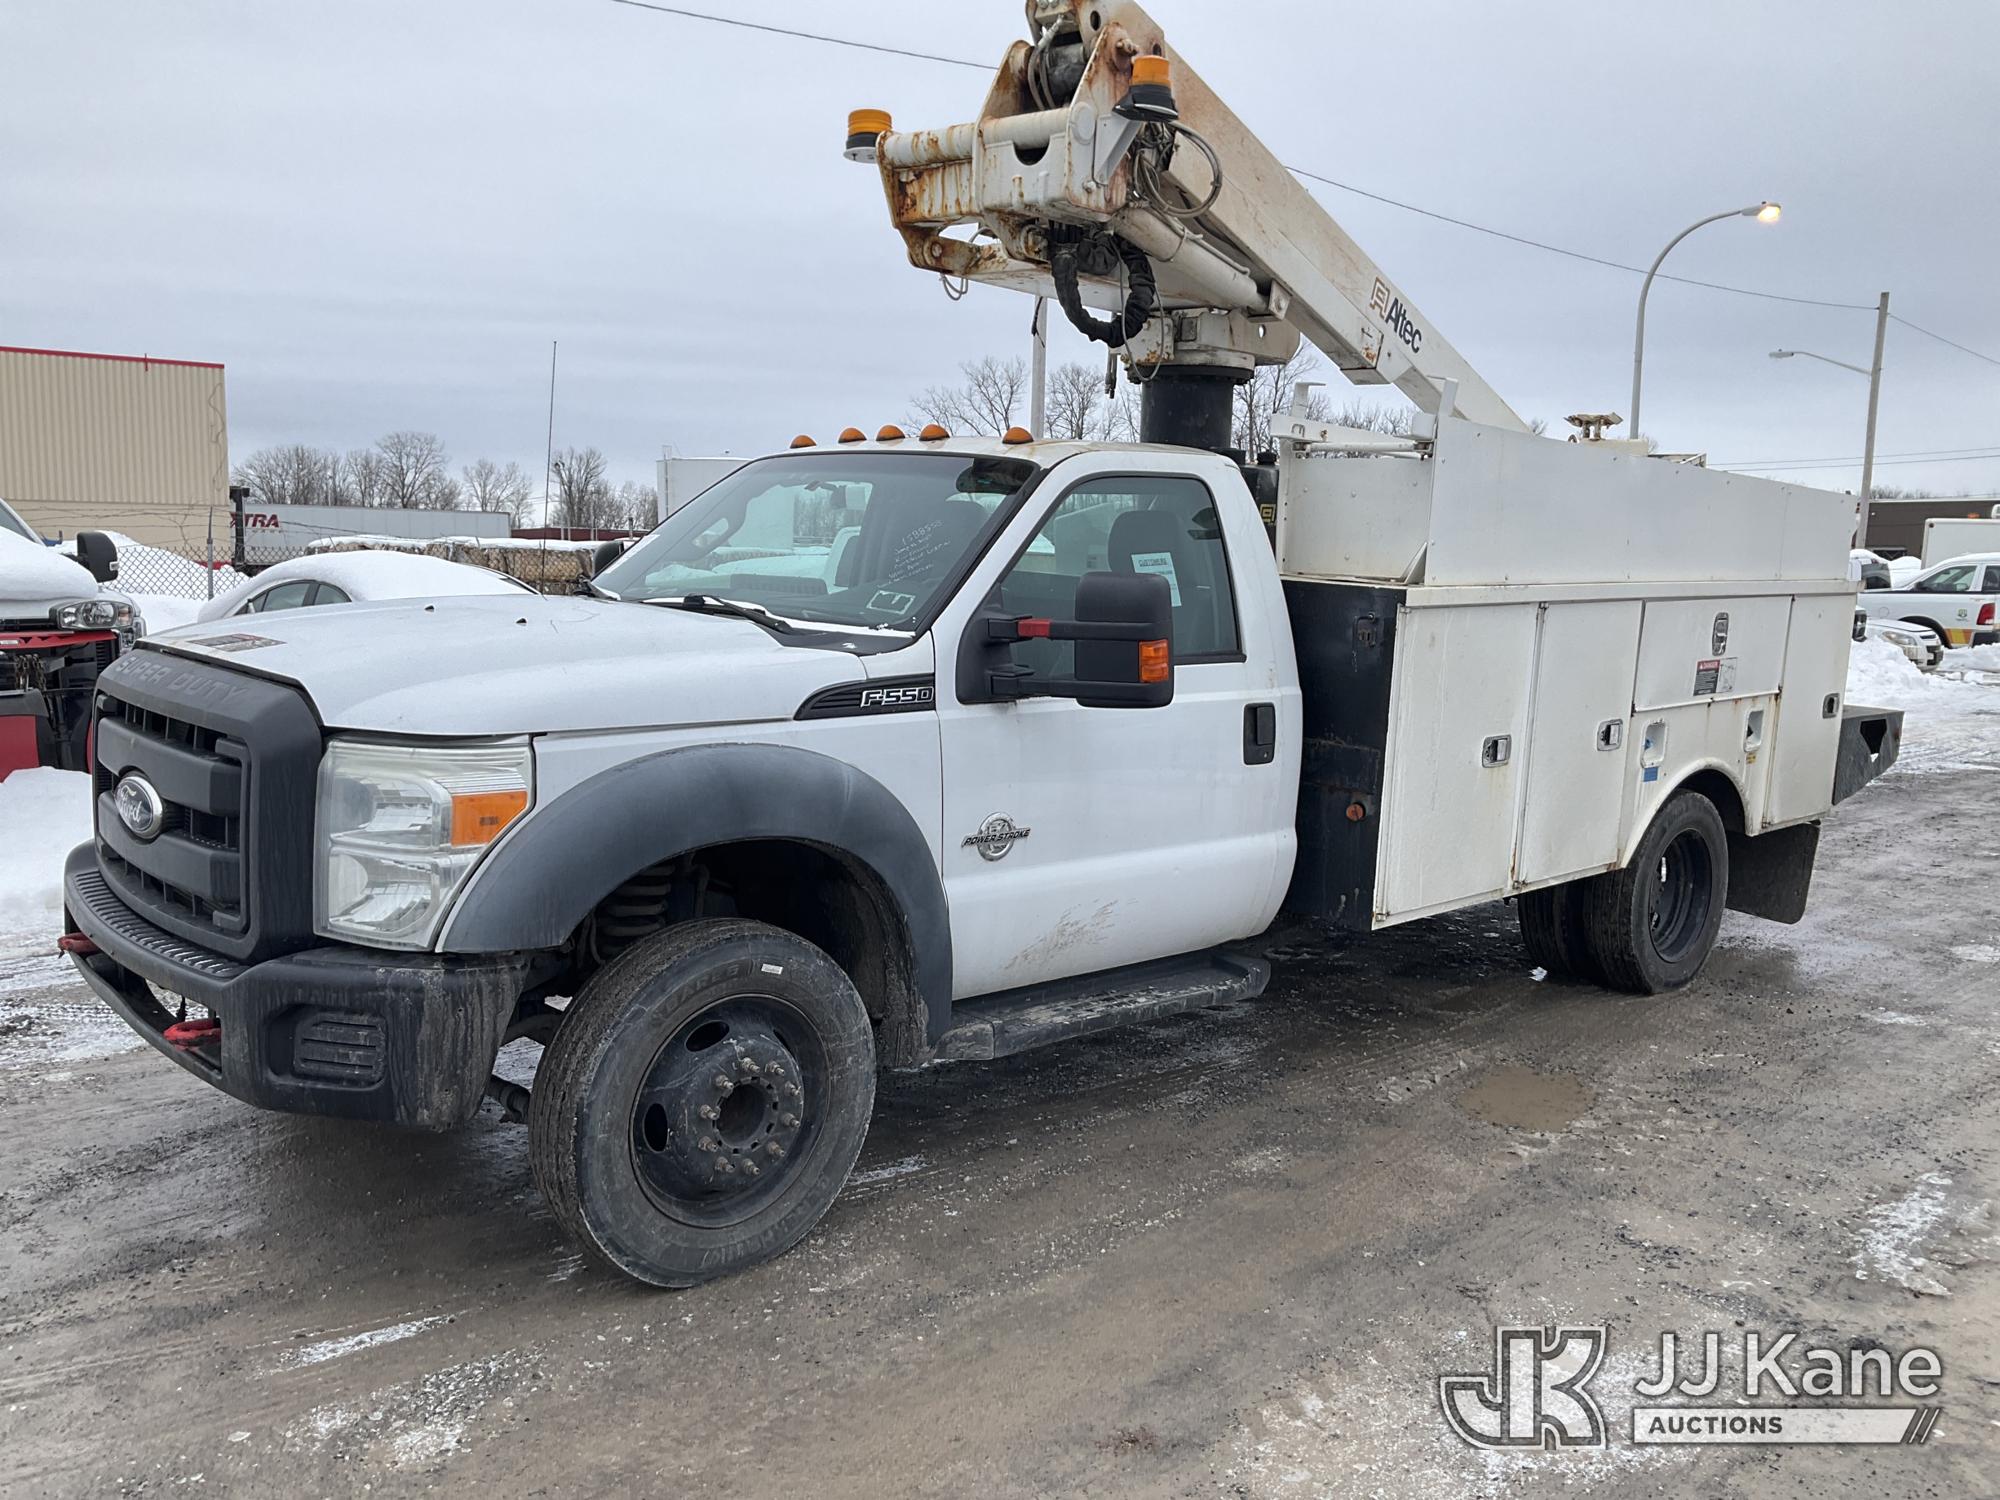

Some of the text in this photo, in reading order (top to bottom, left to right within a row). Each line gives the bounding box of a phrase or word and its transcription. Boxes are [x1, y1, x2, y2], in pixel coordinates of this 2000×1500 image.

[1385, 297, 1422, 354] Altec
[115, 656, 249, 704] SUPER DUTY
[860, 686, 935, 708] F-550
[117, 784, 143, 824] Ford
[963, 834, 997, 847] POWER
[996, 828, 1031, 842] STROKE
